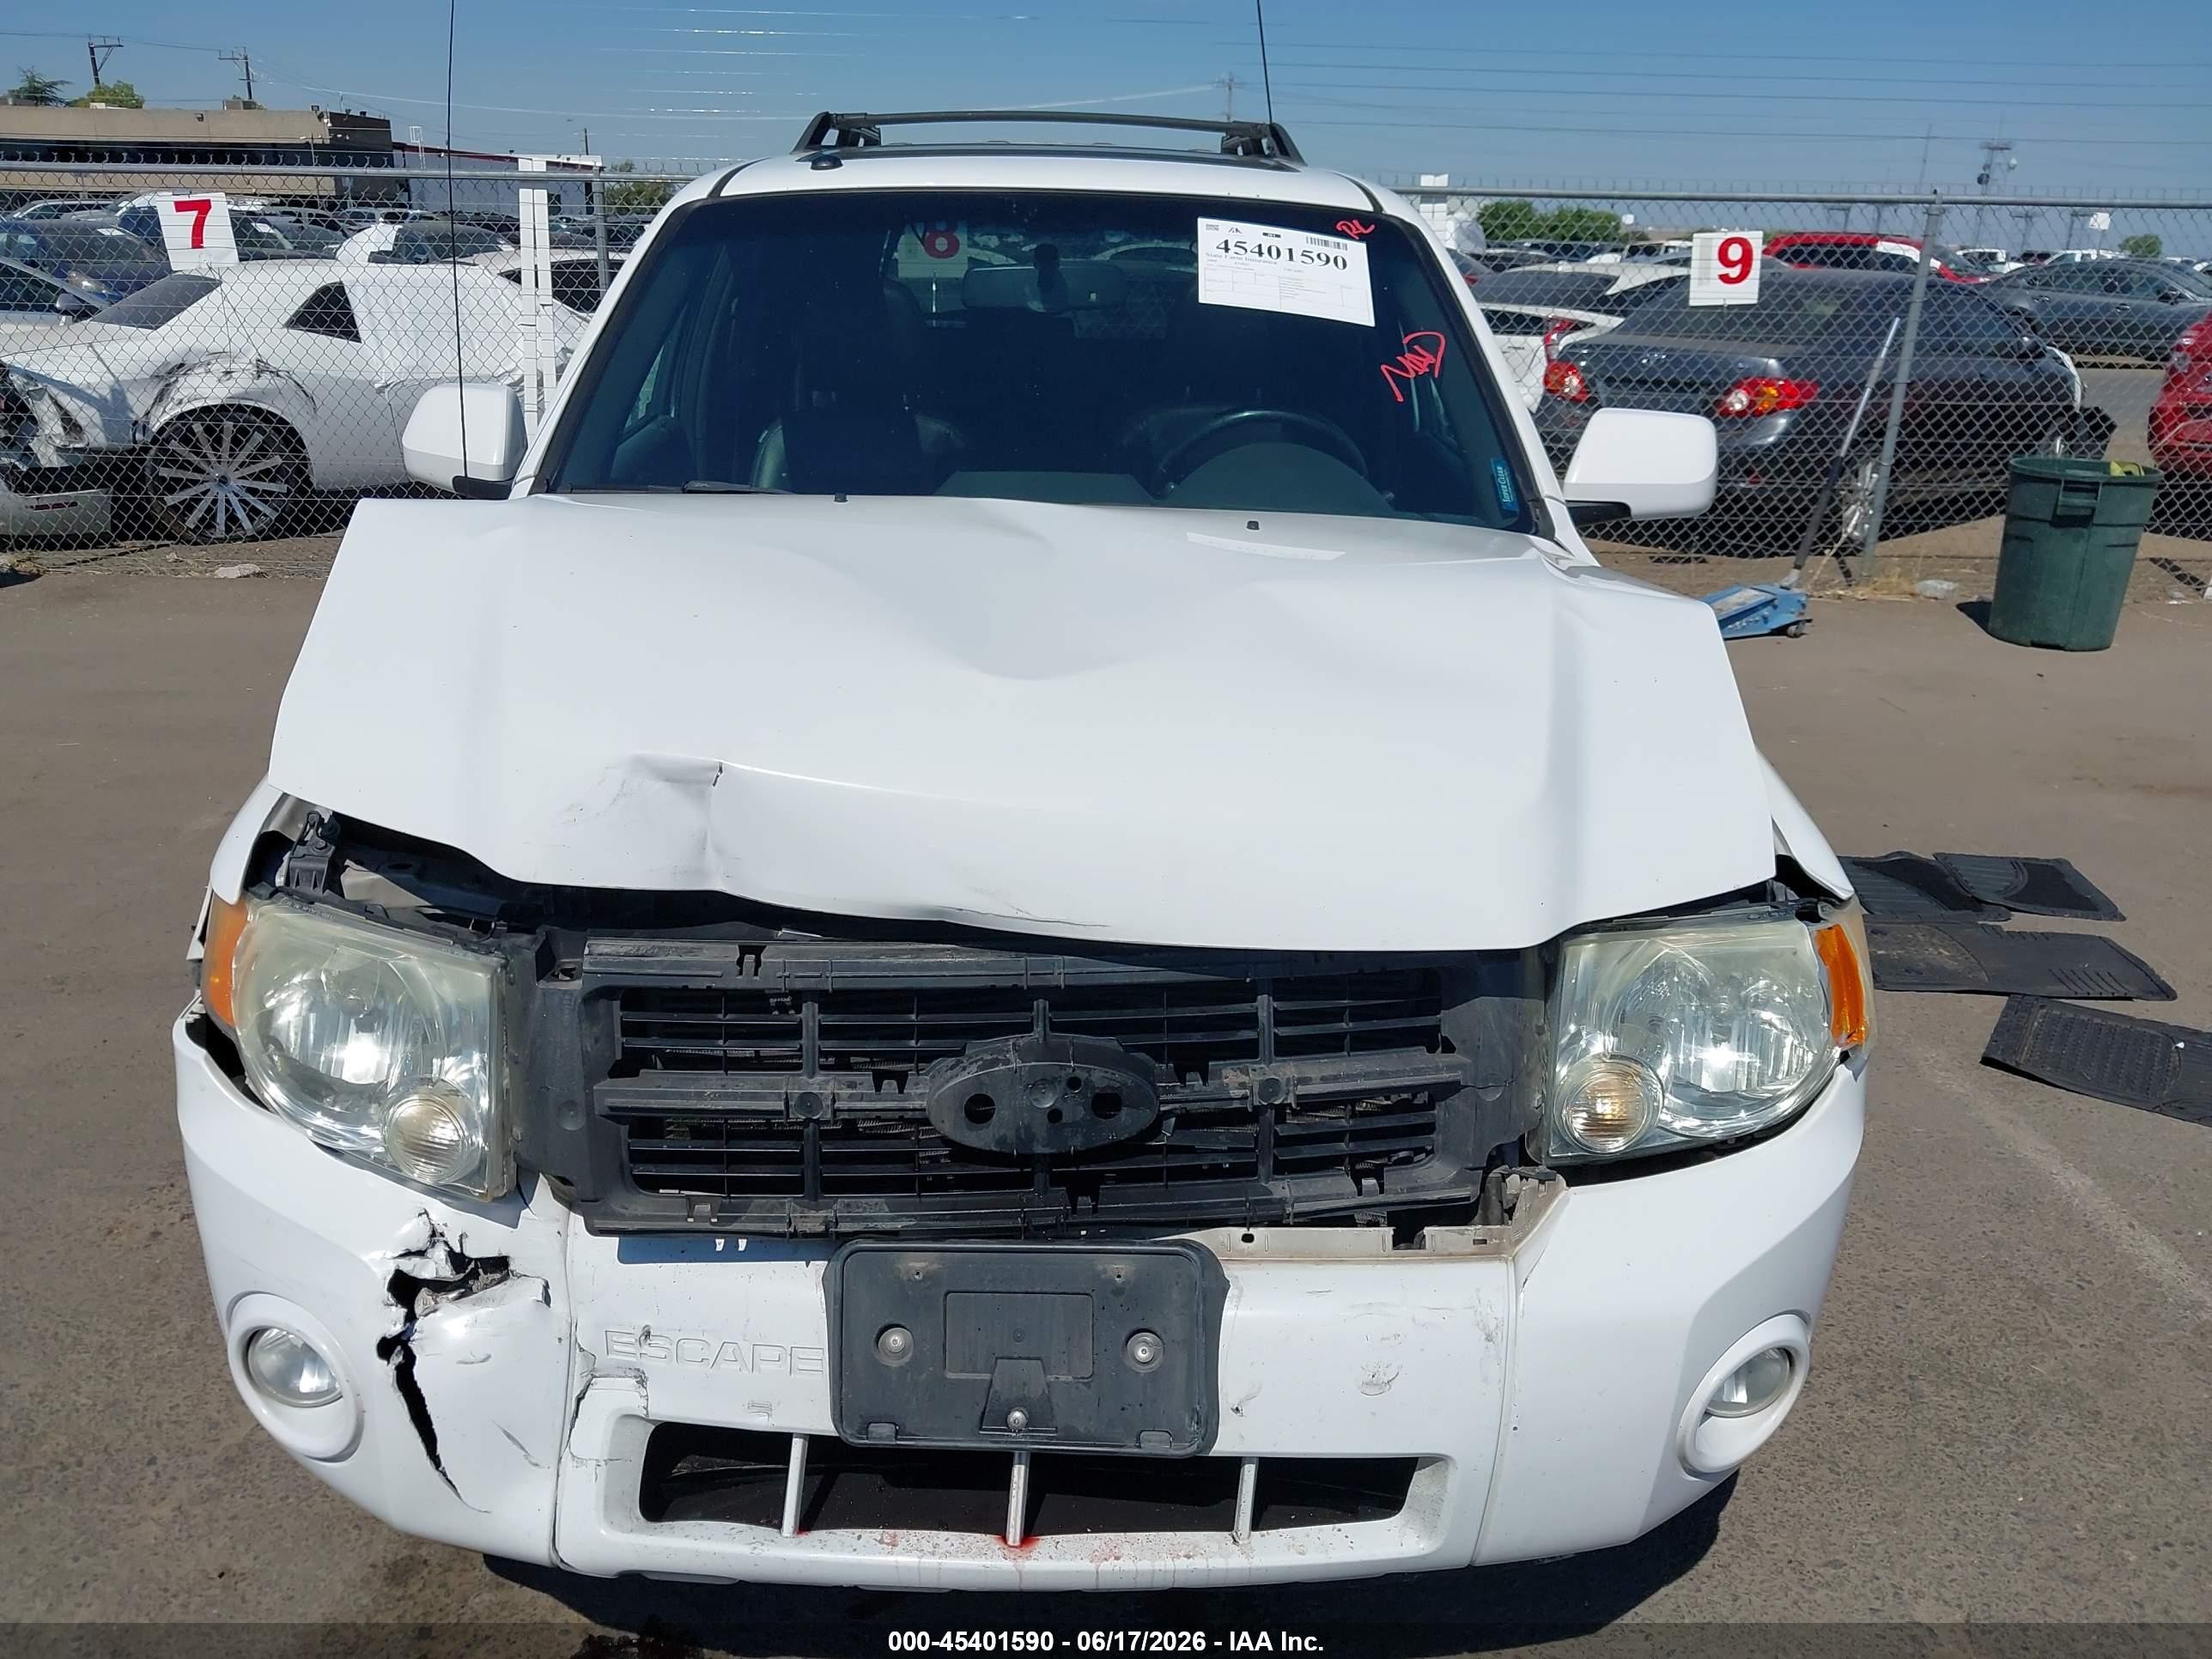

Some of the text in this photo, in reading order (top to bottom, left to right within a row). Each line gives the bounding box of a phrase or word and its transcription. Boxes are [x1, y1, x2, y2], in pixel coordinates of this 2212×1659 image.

[173, 198, 212, 249] 7
[1216, 239, 1347, 270] 45401590
[1718, 236, 1753, 284] 9
[605, 1329, 825, 1377] ESCAPE
